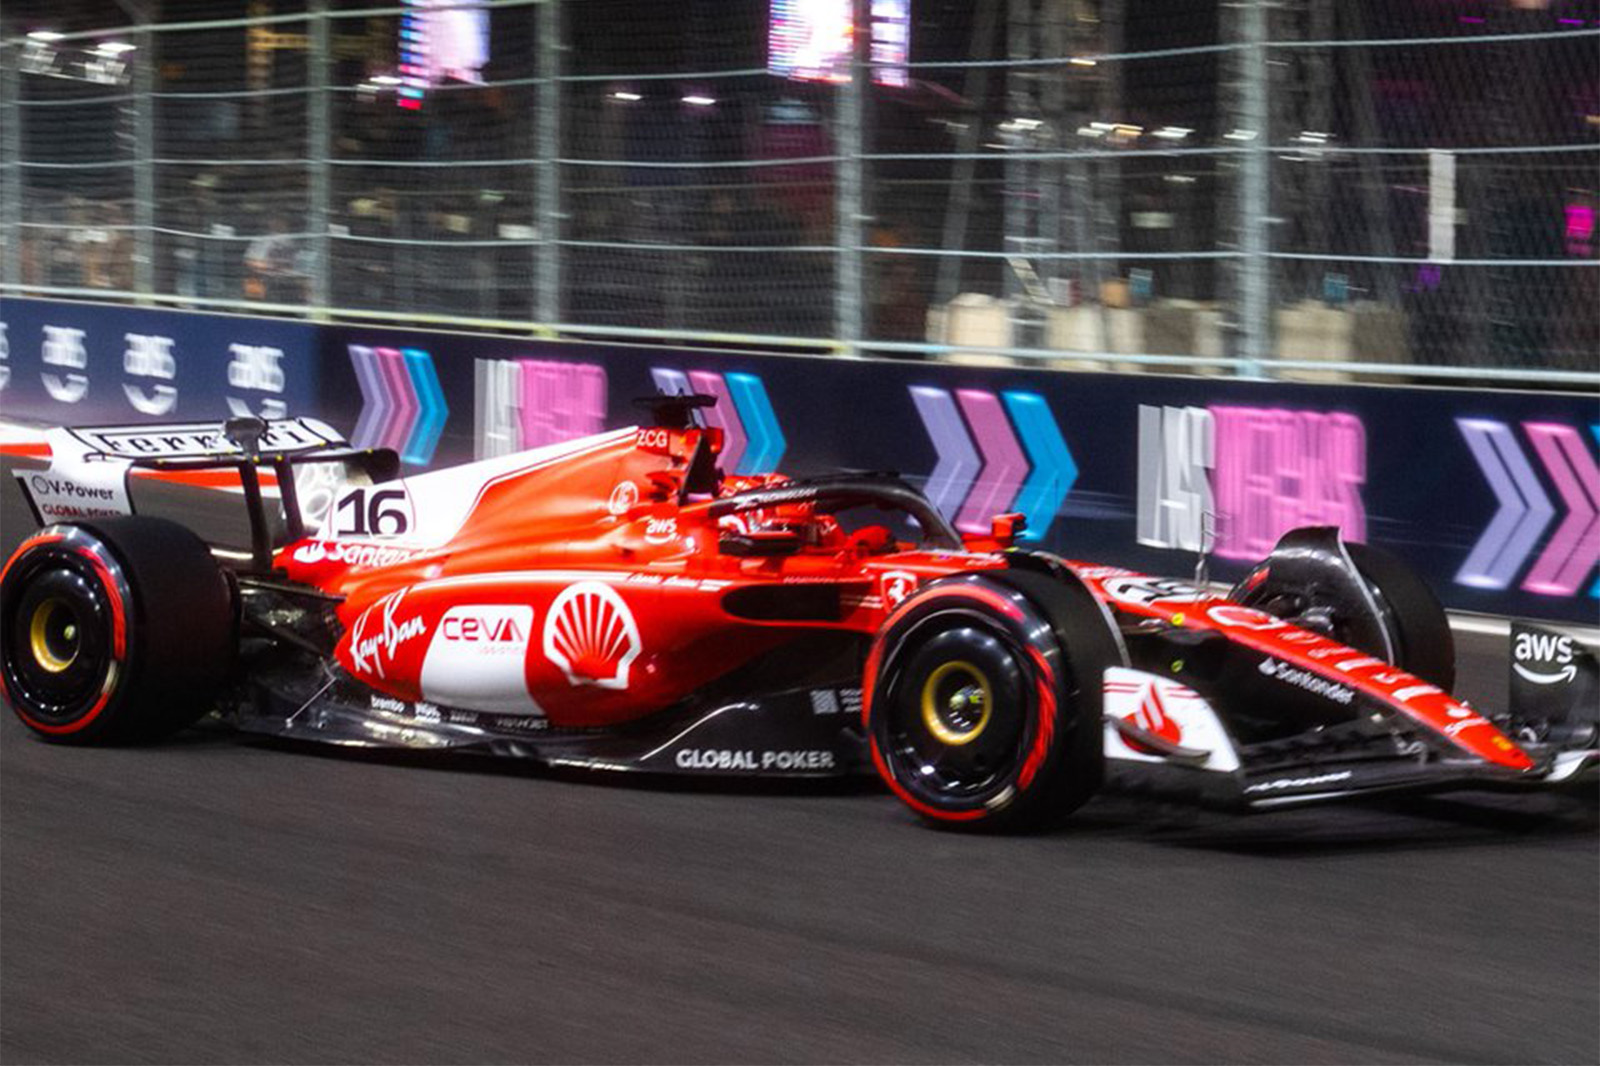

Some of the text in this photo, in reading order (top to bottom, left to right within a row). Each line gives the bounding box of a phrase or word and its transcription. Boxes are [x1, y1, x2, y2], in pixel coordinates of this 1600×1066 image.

[91, 424, 305, 452] Ferrri
[636, 429, 669, 448] ZCG
[42, 503, 86, 518] GLOBAL
[337, 488, 408, 537] 16
[646, 518, 677, 534] aws
[1515, 632, 1574, 664] aws
[675, 749, 836, 769] GLOBAL POKER
